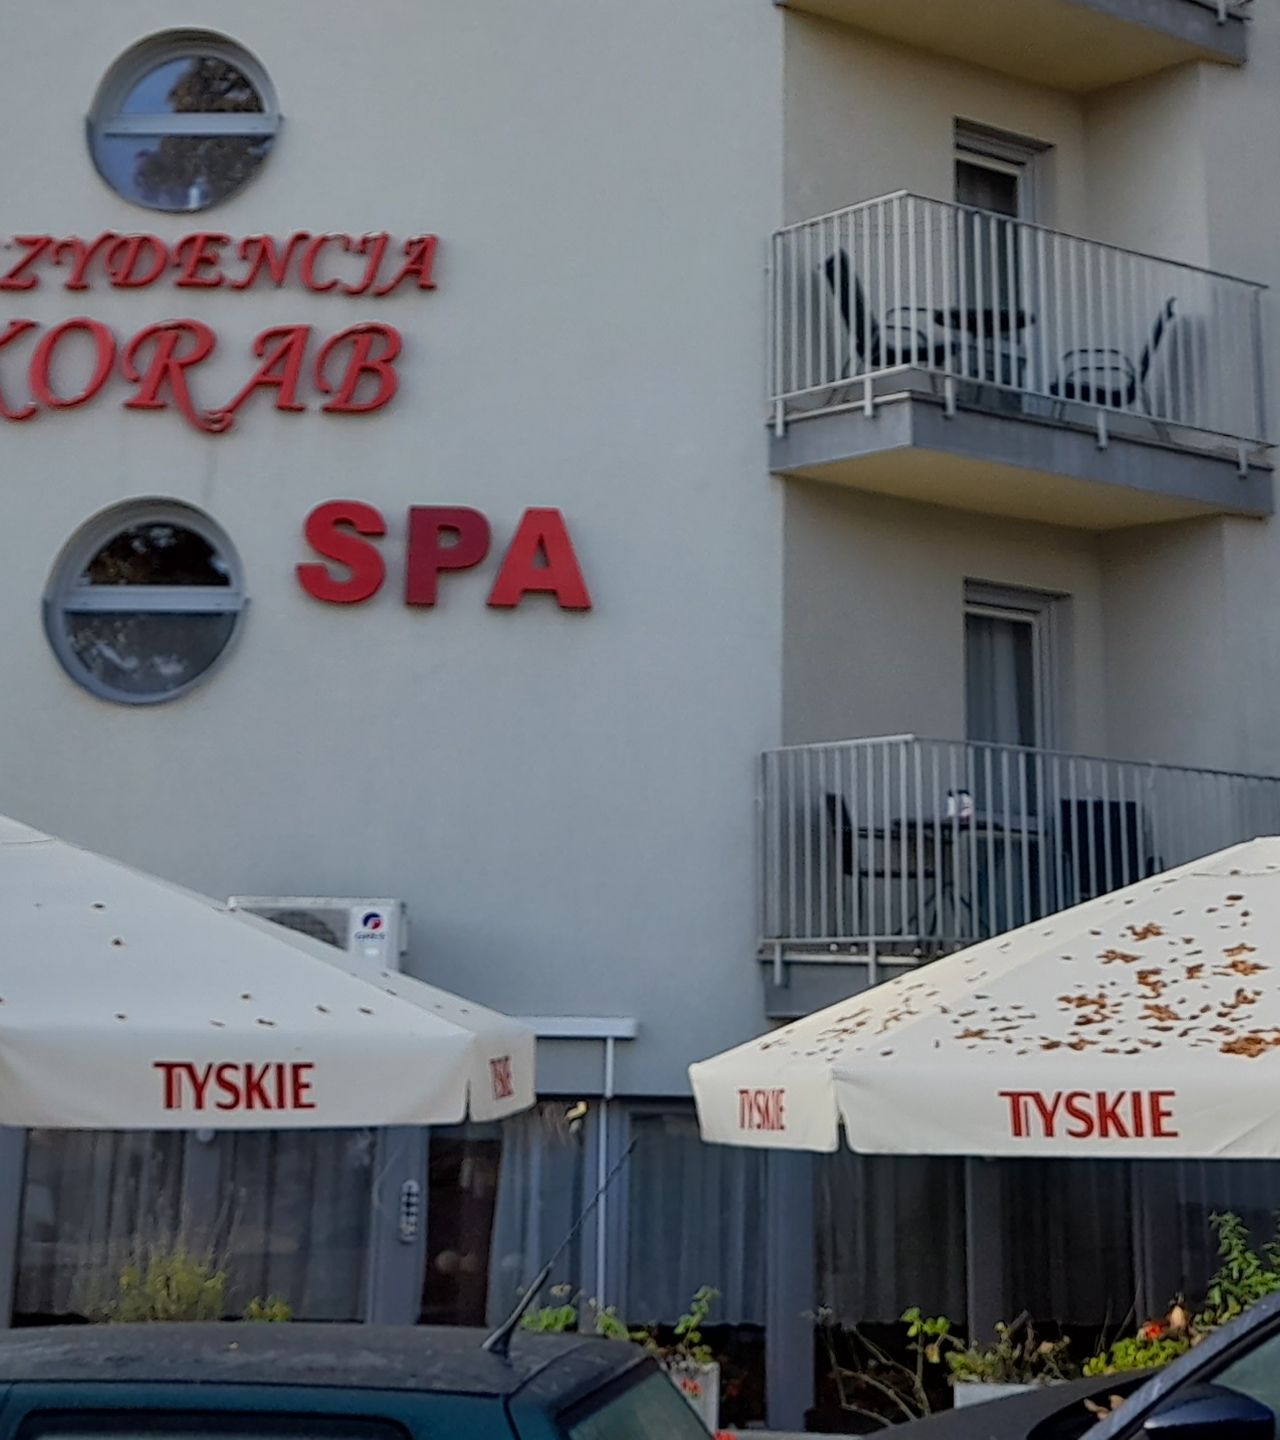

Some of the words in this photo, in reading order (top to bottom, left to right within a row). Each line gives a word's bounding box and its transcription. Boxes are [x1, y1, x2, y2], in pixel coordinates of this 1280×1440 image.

[297, 500, 593, 610] SPA
[154, 1062, 317, 1112] TYSKIE
[738, 1088, 787, 1131] TYSKIE
[998, 1089, 1179, 1141] TYSKIE
